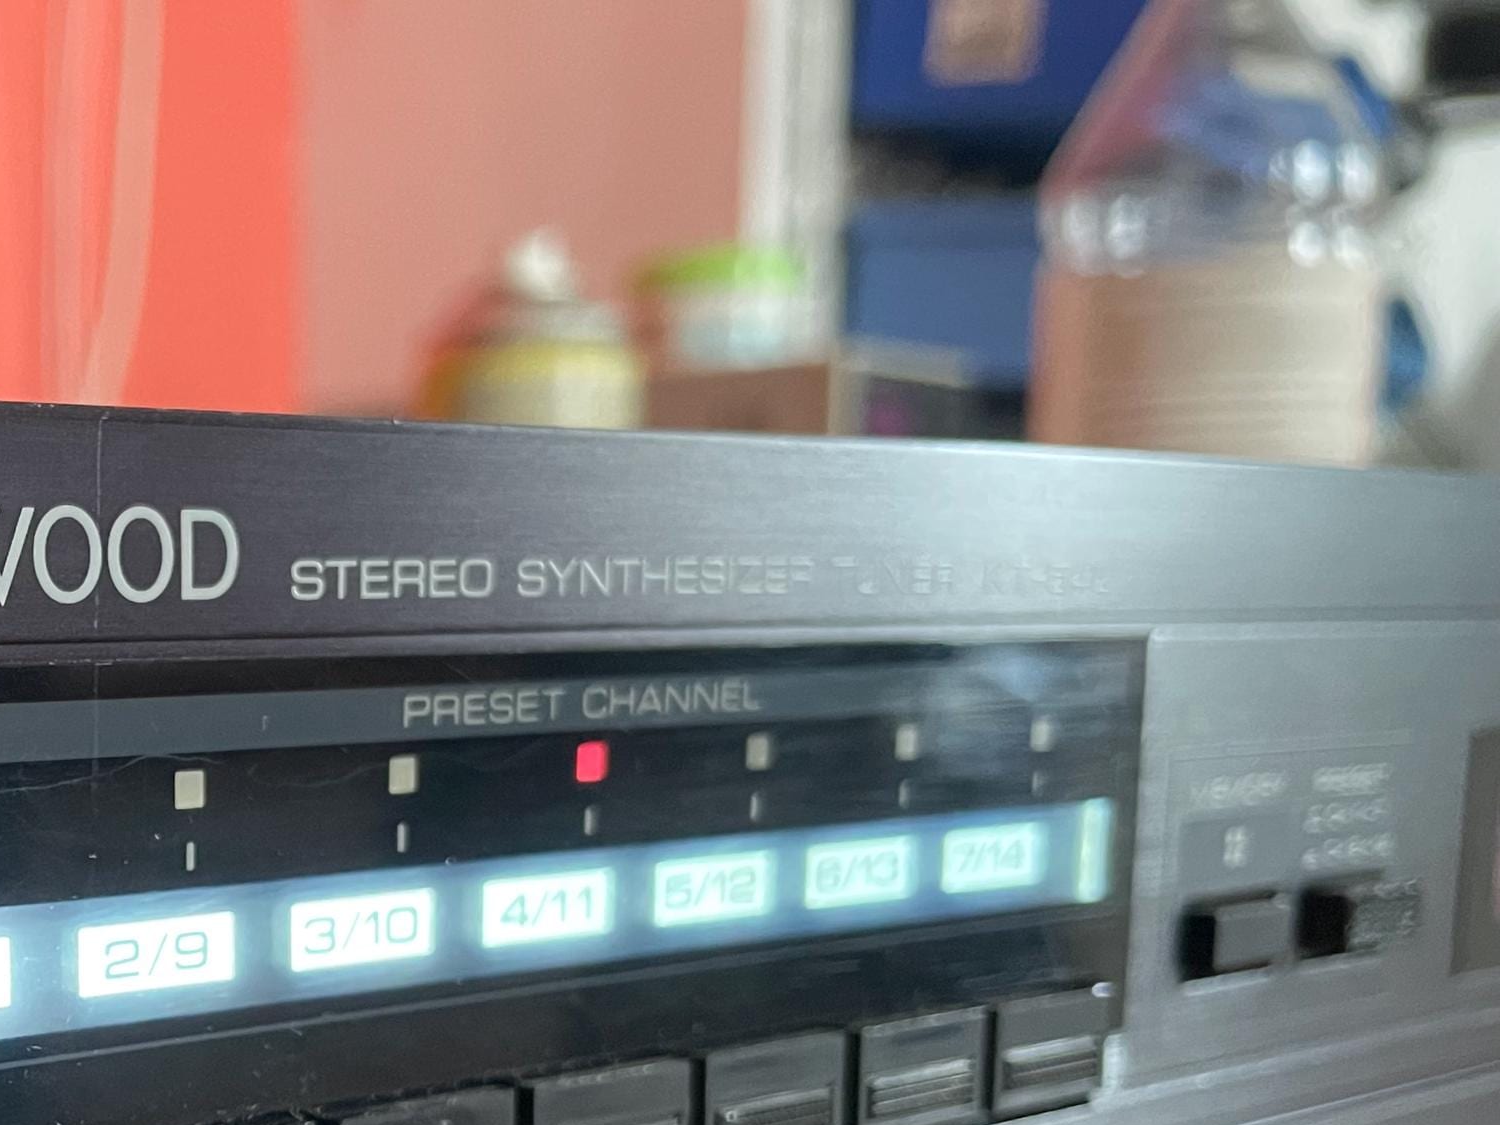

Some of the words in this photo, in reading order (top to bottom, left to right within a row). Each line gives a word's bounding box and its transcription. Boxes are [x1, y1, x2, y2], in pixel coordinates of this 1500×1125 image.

[289, 557, 495, 602] STEREO
[516, 555, 815, 599] SYNTHESIZER
[402, 688, 565, 729] PRESET
[581, 679, 763, 721] CHANNEL
[104, 931, 210, 982] 2/9
[303, 906, 420, 955] 3/10
[500, 885, 596, 929] 4/11
[664, 864, 757, 909] 5/12
